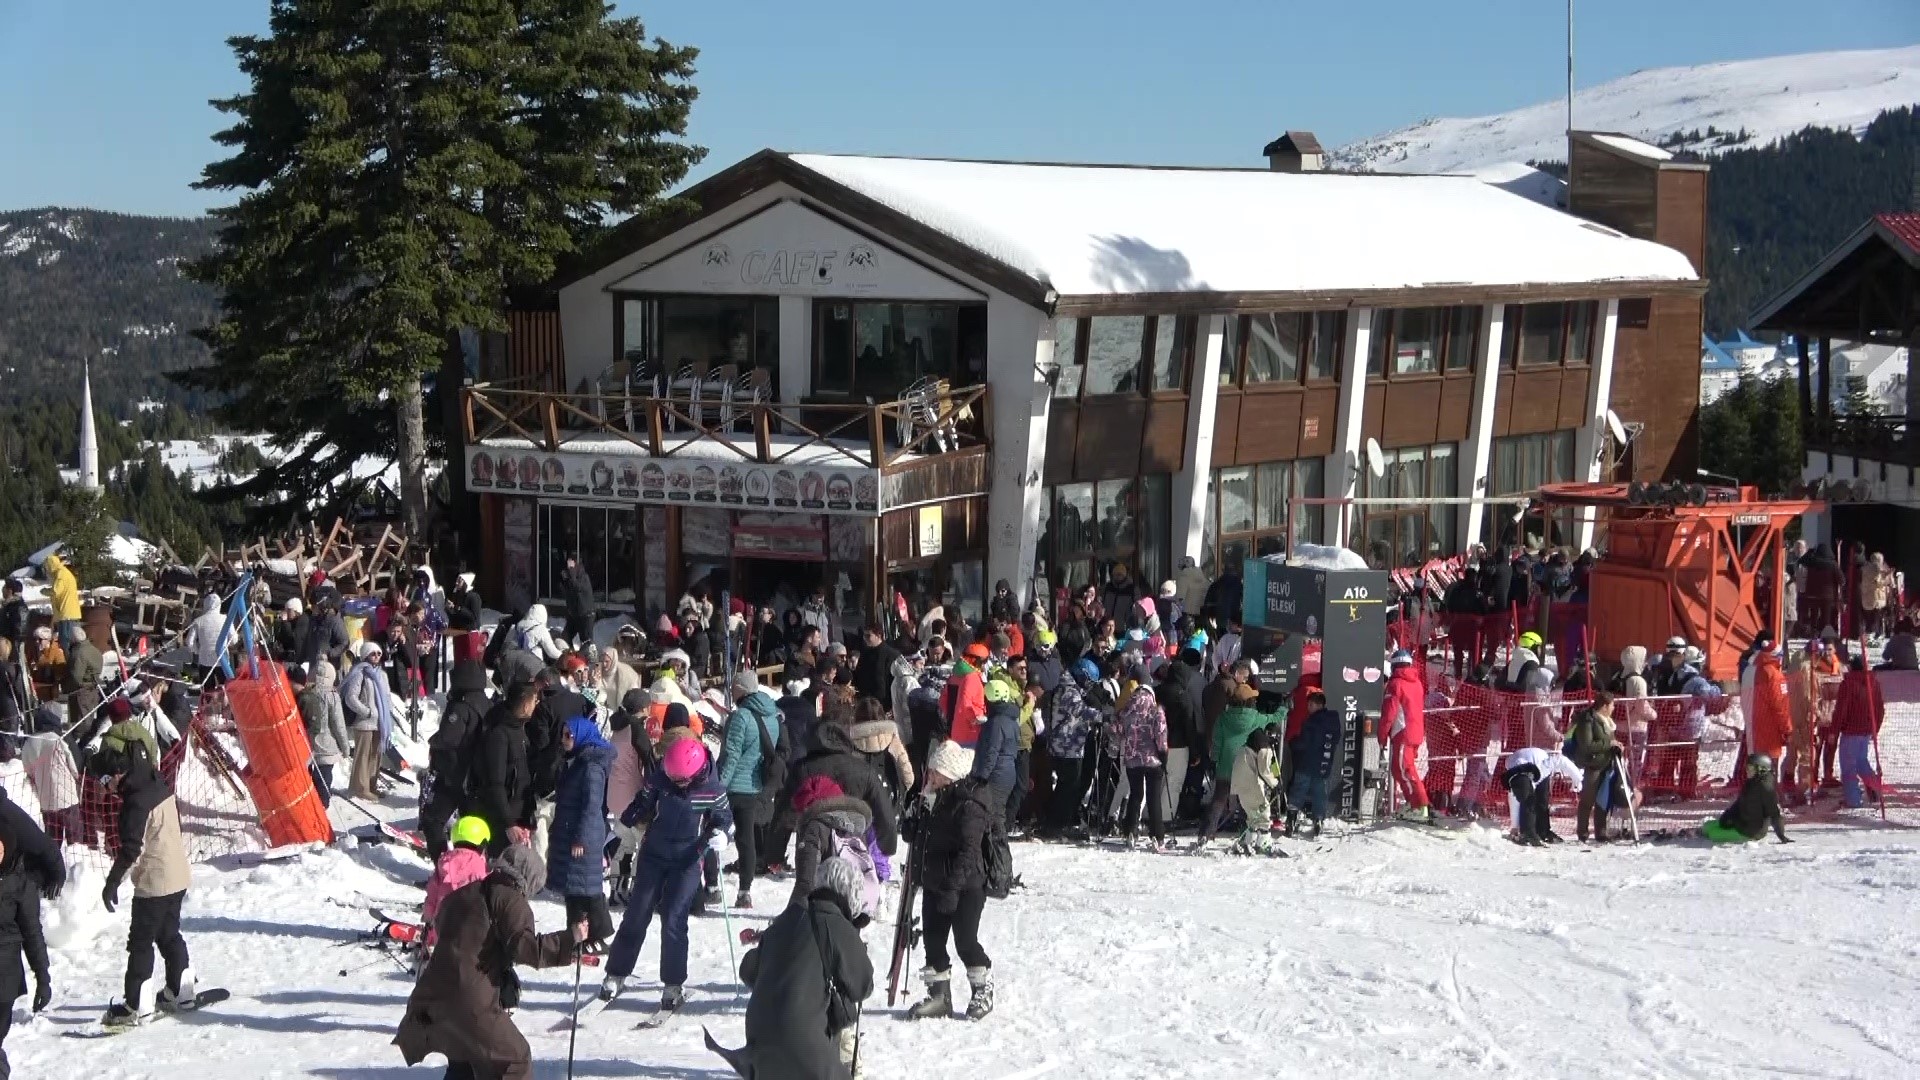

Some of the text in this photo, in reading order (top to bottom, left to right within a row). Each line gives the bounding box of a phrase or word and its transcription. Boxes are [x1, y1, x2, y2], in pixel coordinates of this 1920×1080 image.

[740, 249, 837, 285] CAFE
[1735, 515, 1768, 523] LEITNER
[1267, 581, 1291, 597] BELVÜ
[1344, 586, 1368, 599] A10
